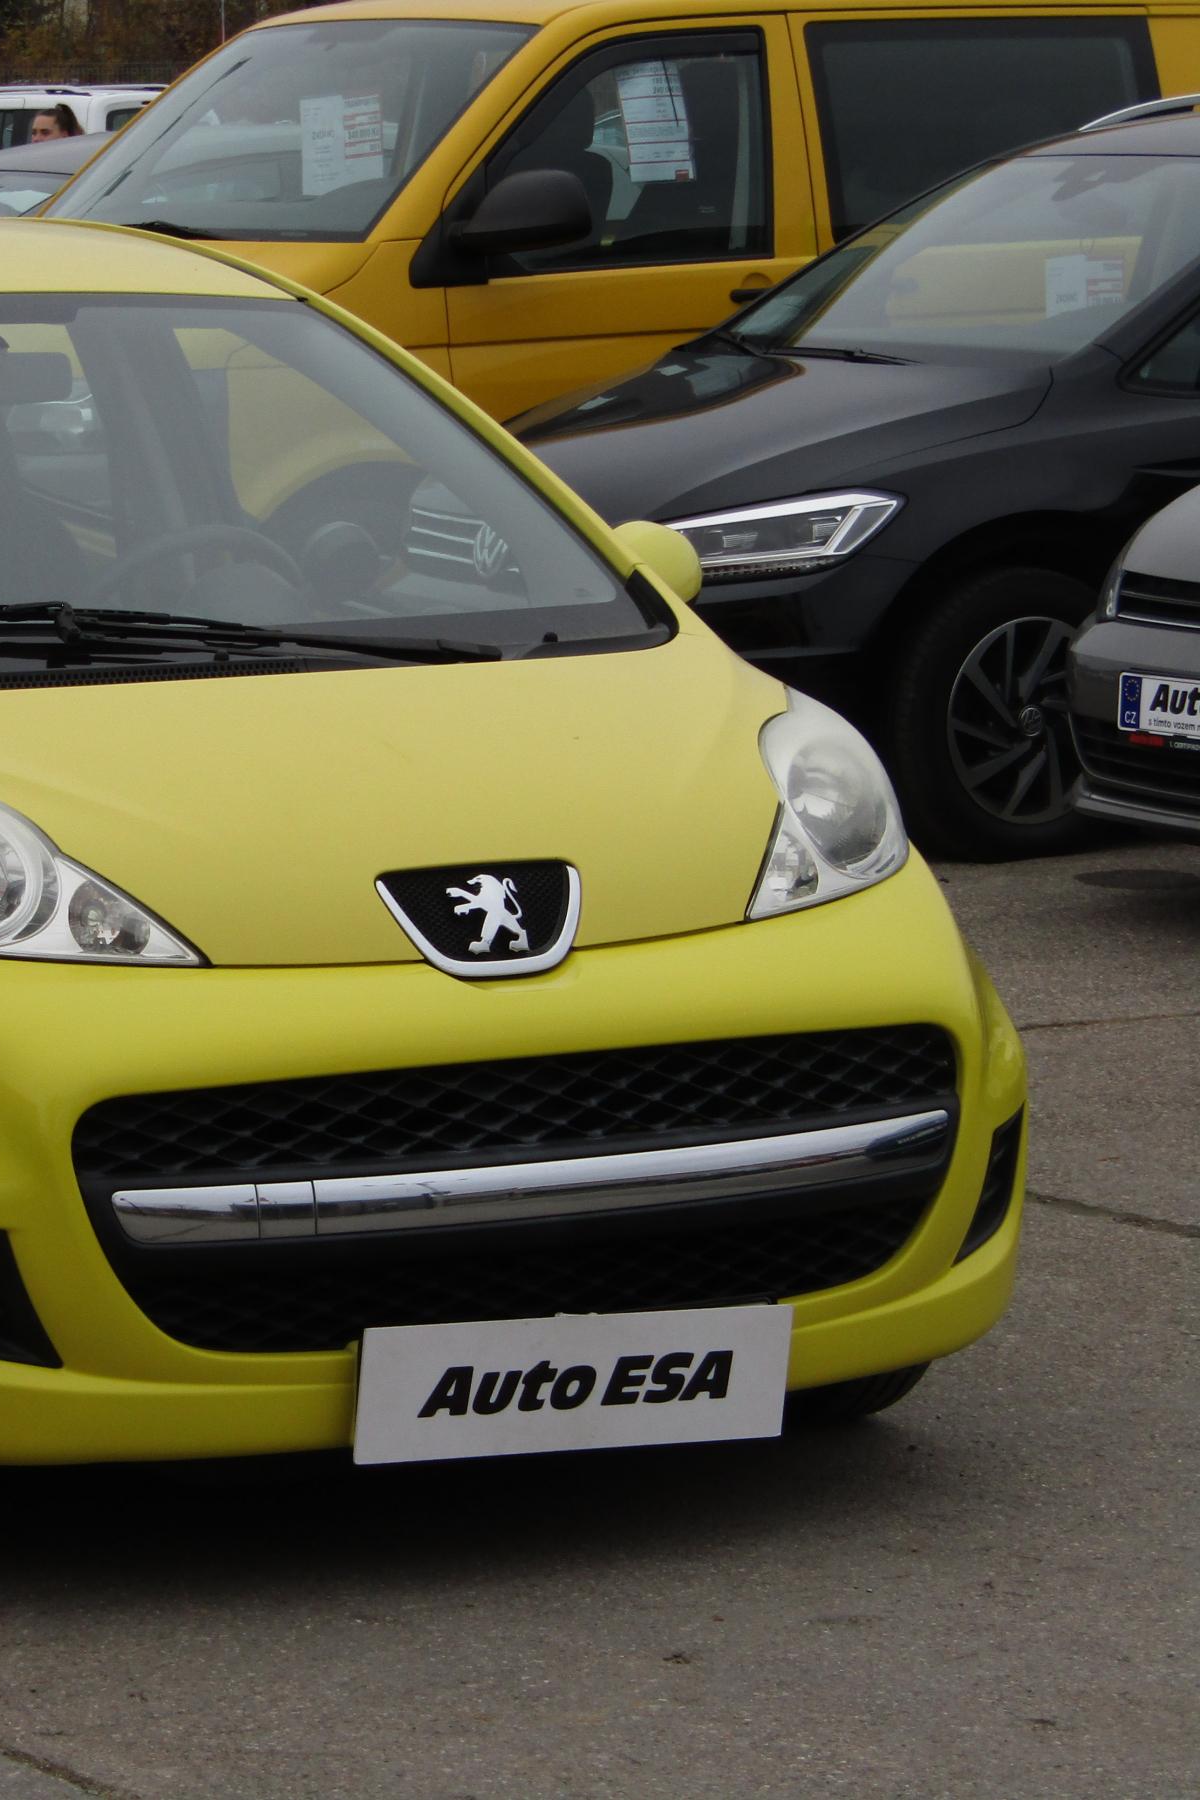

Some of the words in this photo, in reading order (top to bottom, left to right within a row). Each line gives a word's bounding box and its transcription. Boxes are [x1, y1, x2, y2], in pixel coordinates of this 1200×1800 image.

[1124, 711, 1136, 724] CZ
[417, 1360, 597, 1418] Auto
[600, 1350, 734, 1406] ESA
